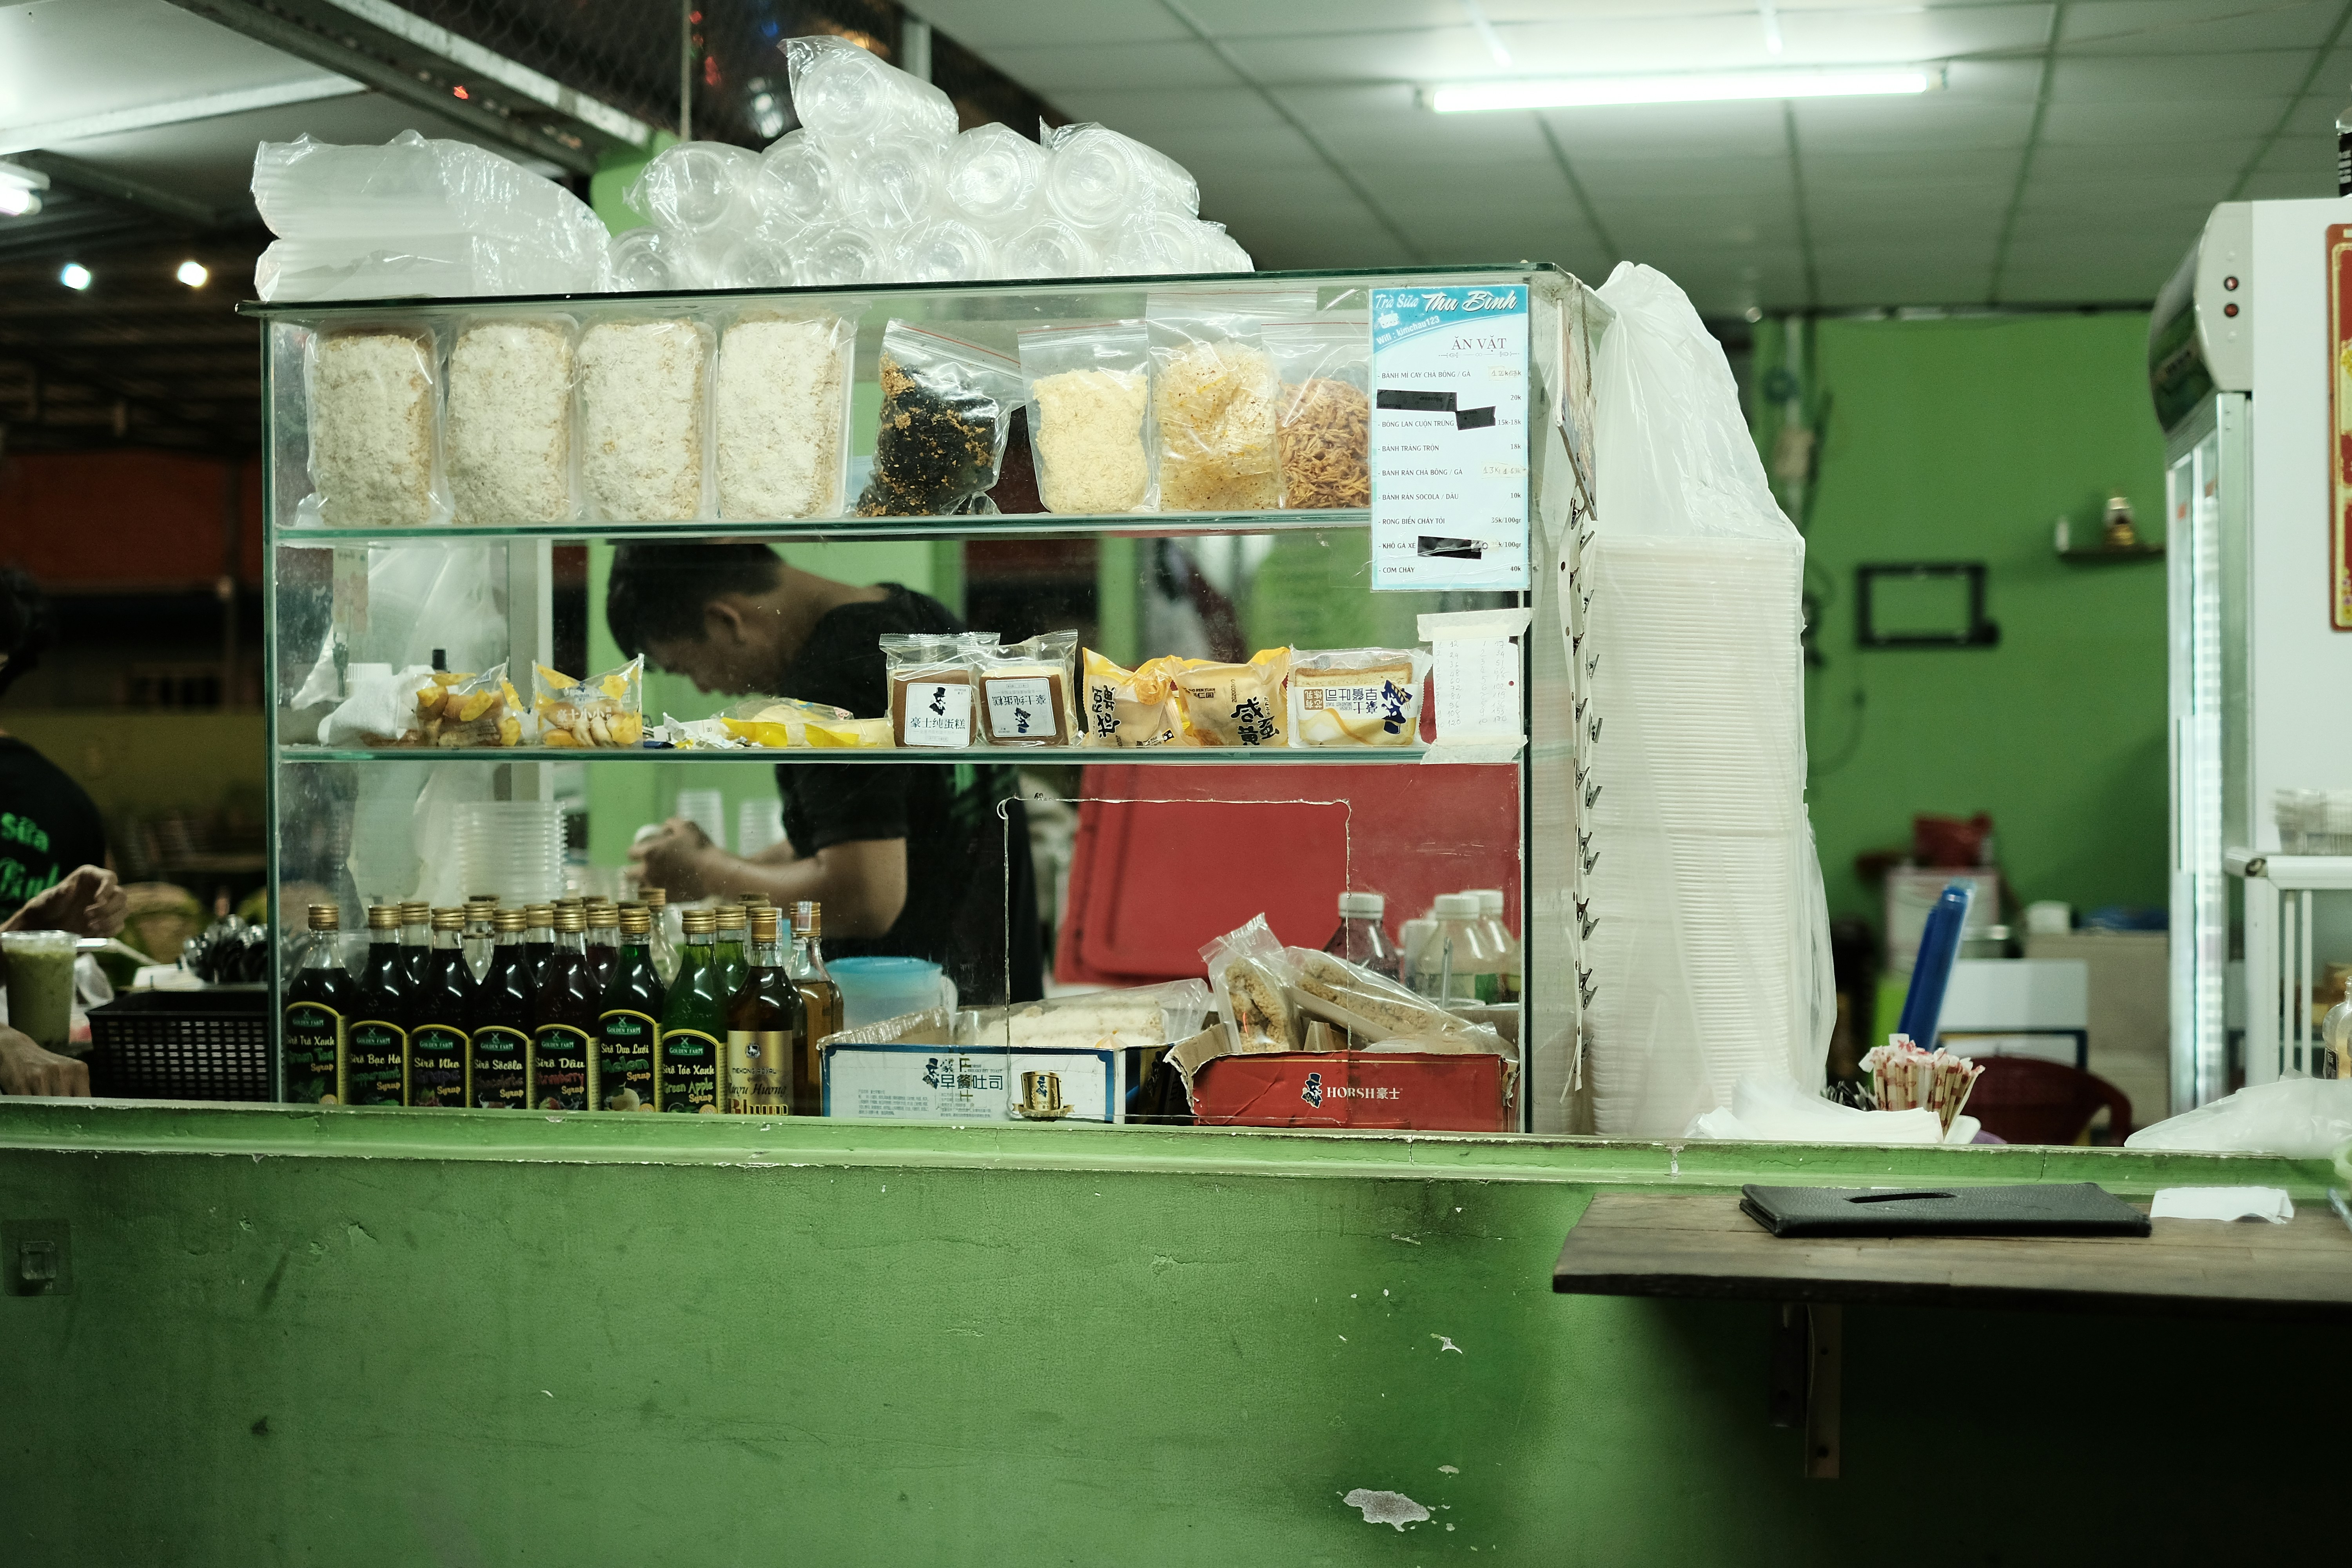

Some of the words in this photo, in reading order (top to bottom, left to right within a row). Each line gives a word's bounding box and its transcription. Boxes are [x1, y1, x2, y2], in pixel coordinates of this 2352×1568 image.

[1376, 294, 1394, 309] Trà
[1397, 294, 1419, 308] Sữa
[1421, 292, 1459, 312] Thu
[1462, 290, 1518, 312] Bình
[1396, 315, 1440, 337] kimchau123
[1451, 336, 1473, 350] ĂN
[1477, 335, 1507, 352] VẶT
[1496, 650, 1504, 658] 34
[1481, 676, 1488, 684] 5
[1325, 688, 1378, 701] 早餐吐司
[1353, 701, 1378, 714] 豪士
[1448, 710, 1461, 718] 108
[314, 1036, 335, 1045] Xanh
[558, 1058, 585, 1069] Dâu
[693, 1064, 715, 1075] Xanh
[627, 1072, 651, 1082] Syrup
[941, 1074, 1003, 1090] 早餐吐司
[437, 1085, 461, 1096] Syrup
[500, 1089, 524, 1099] Syrup
[561, 1085, 584, 1096] Syrup
[1327, 1087, 1375, 1099] HORSH
[1376, 1087, 1400, 1100] 豪士
[689, 1094, 713, 1103] Syrup
[729, 1098, 788, 1116] Rhum
